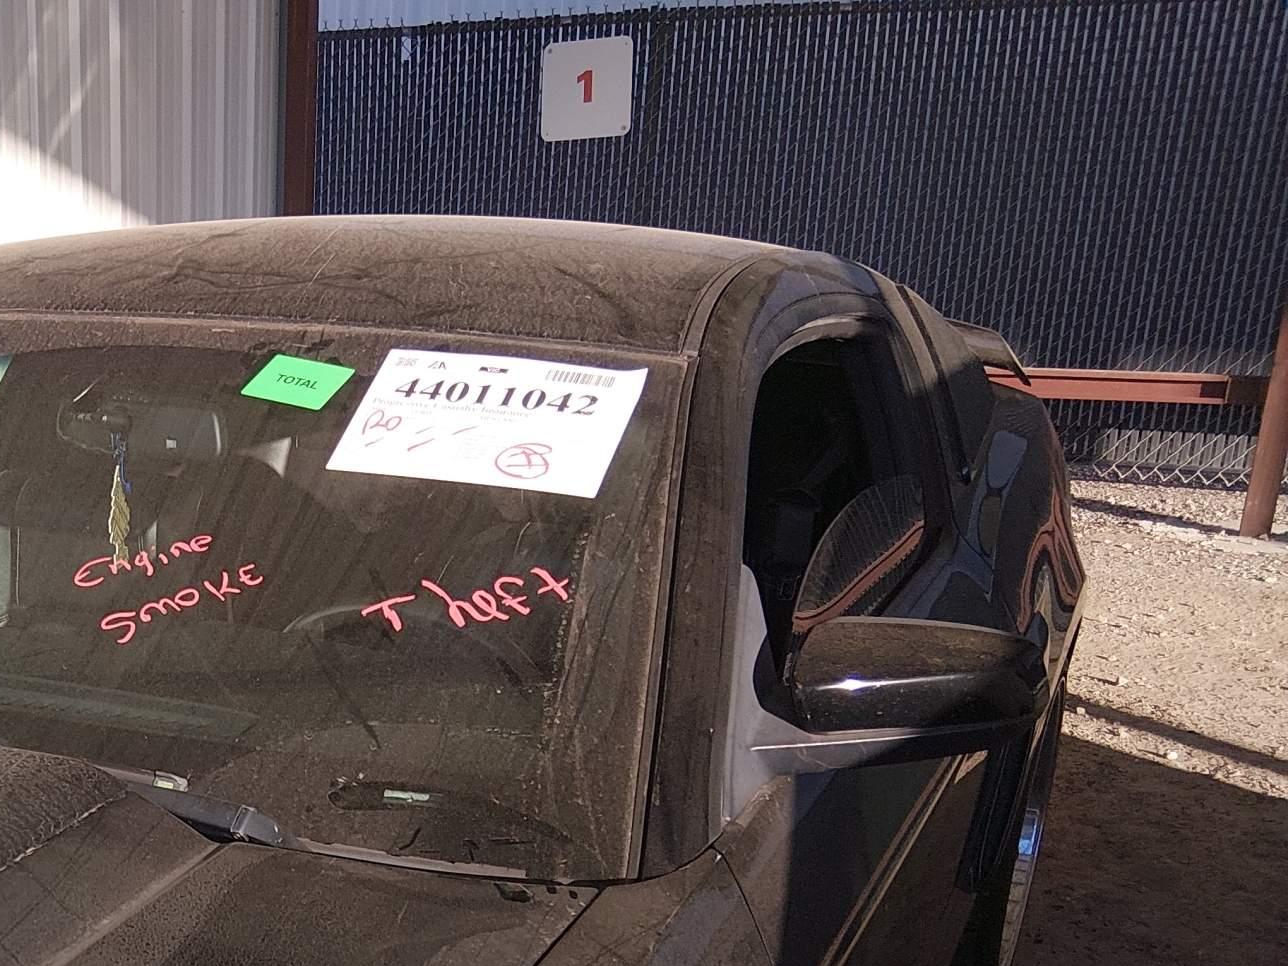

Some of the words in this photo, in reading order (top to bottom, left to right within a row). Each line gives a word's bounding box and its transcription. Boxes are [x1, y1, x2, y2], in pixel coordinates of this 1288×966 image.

[577, 70, 593, 103] 1
[276, 372, 319, 391] TOTAL
[394, 377, 600, 416] 44011042
[73, 534, 214, 588] Engine
